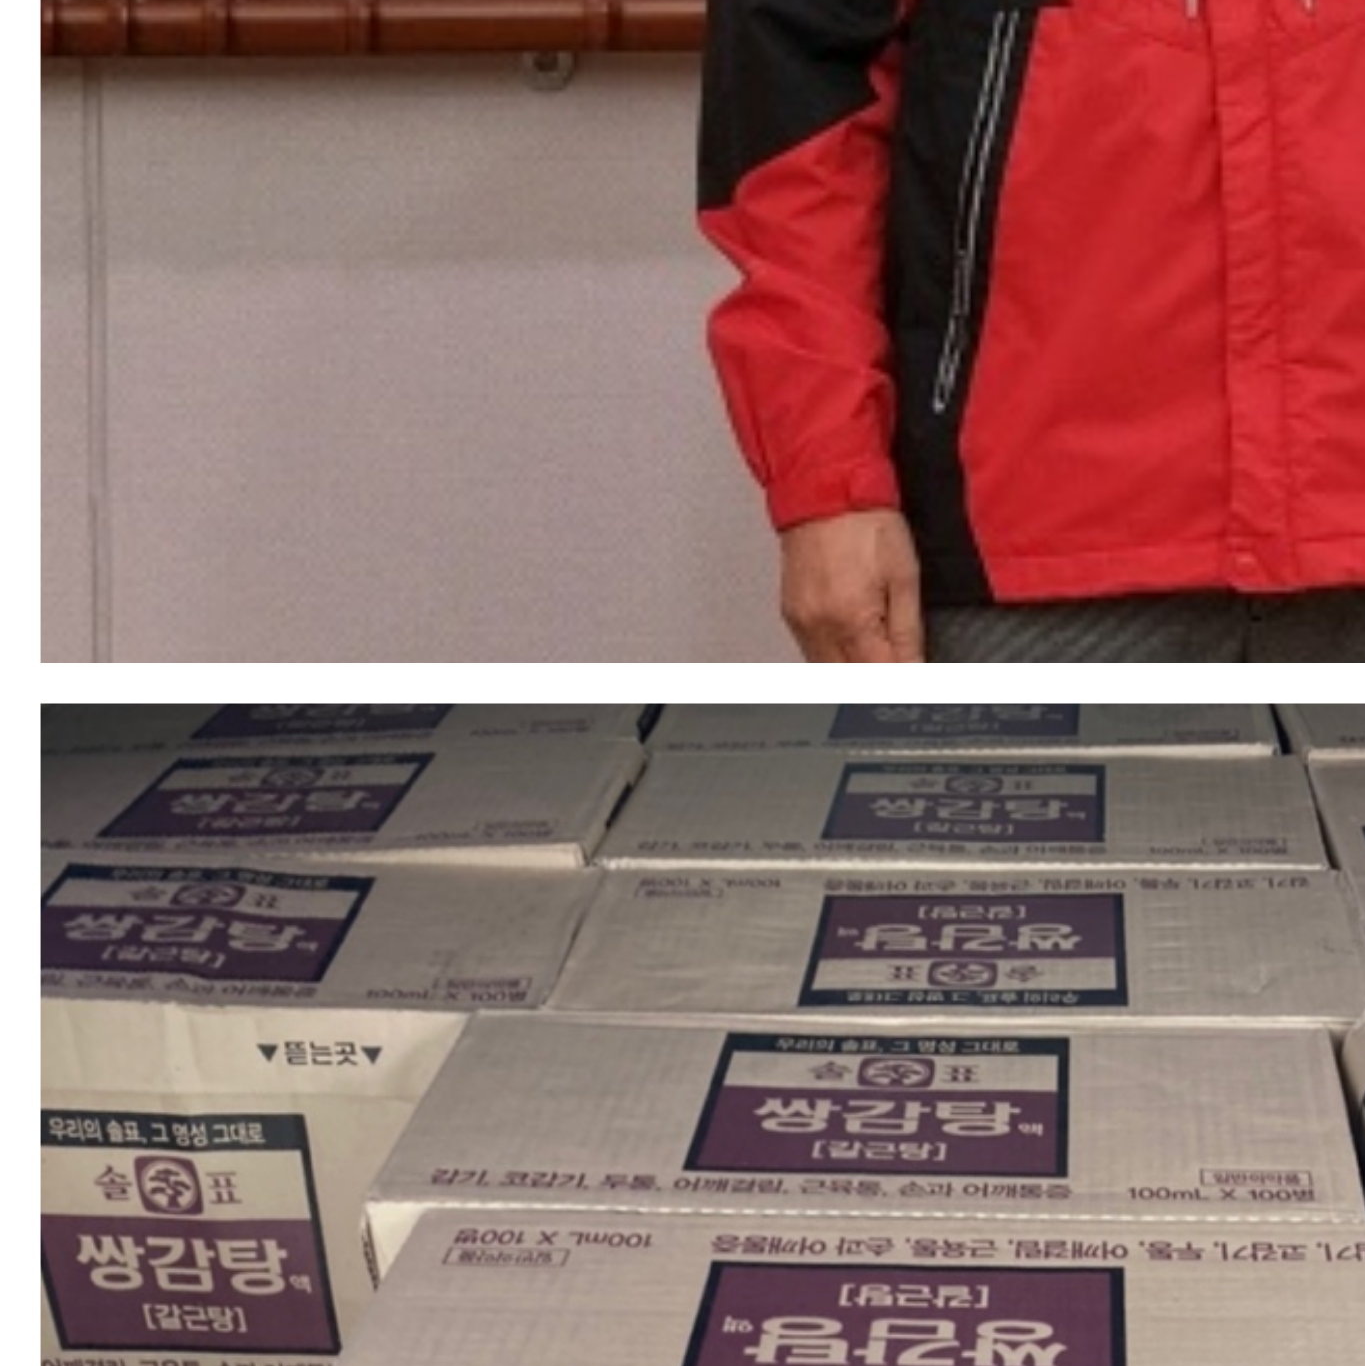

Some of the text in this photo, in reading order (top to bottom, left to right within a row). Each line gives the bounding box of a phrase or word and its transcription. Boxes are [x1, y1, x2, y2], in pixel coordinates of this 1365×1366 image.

[284, 1041, 358, 1067] 뜯는곳
[943, 1065, 980, 1083] 표
[755, 1097, 1020, 1135] 쌍감탕
[47, 1117, 266, 1147] 우리의 솔표, 그 명성 그대로
[811, 1141, 947, 1161] [갈근탕]
[95, 1164, 242, 1207] 솔 표
[568, 1231, 654, 1248] 100mL
[710, 1236, 827, 1256] 어깨통증
[838, 1237, 894, 1257] 손과
[75, 1233, 290, 1296] 쌍감탕
[839, 1284, 987, 1308] [갈근탕]
[142, 1303, 248, 1334] [갈근탕]
